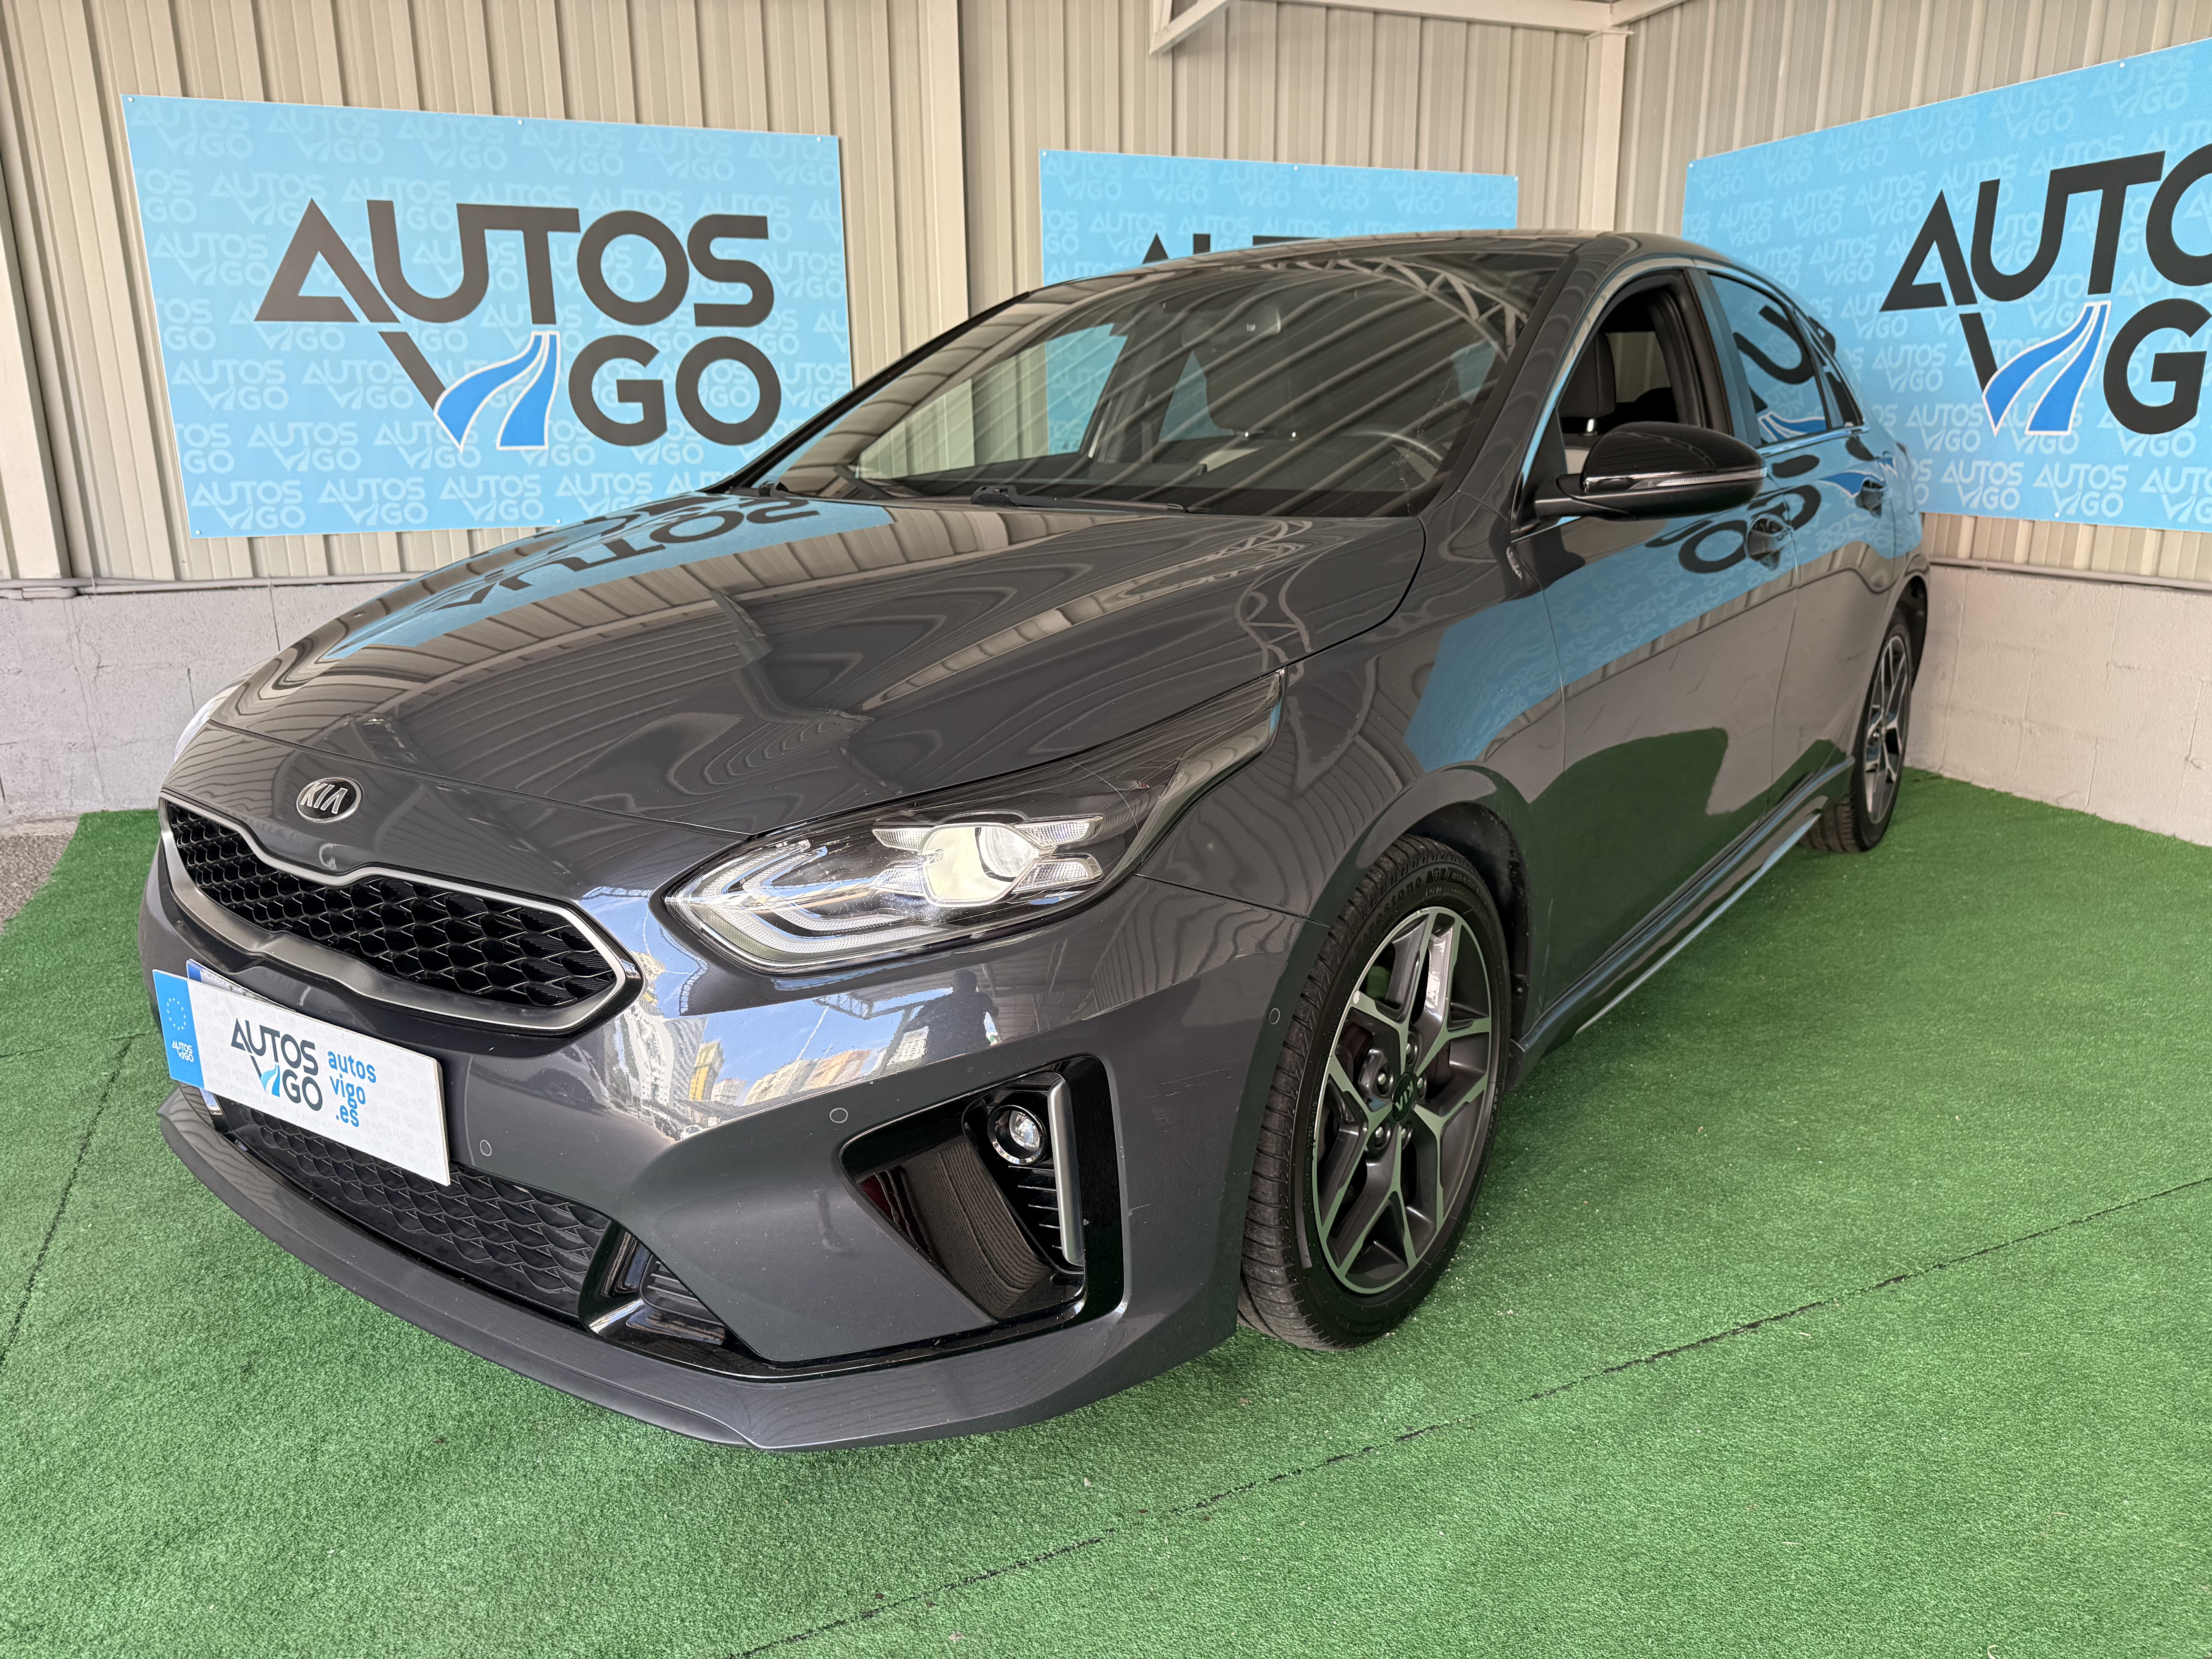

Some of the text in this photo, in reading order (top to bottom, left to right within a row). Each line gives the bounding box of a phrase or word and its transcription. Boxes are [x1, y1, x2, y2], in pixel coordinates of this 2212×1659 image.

[130, 103, 250, 131] AUTOS
[268, 108, 381, 137] AUTOS
[396, 114, 505, 144] AUTOS
[156, 126, 254, 158] VIGO
[291, 132, 383, 163] VIGO
[520, 122, 621, 151] AUTOS
[636, 129, 733, 156] AUTOS
[745, 136, 838, 162] AUTOS
[422, 140, 507, 170] VIGO
[542, 146, 624, 176] VIGO
[657, 153, 734, 181] VIGO
[211, 171, 326, 200] AUTOS
[767, 159, 838, 185] VIGO
[341, 177, 453, 205] AUTOS
[585, 188, 684, 214] AUTOS
[1781, 185, 1848, 218] AUTOS
[1853, 170, 1927, 207] AUTOS
[236, 197, 303, 226] VIG
[1090, 211, 1167, 234] AUTOS
[1716, 199, 1774, 229] AUTOS
[1864, 198, 1923, 226] VIGO
[1879, 143, 2212, 312] AUTO
[151, 232, 269, 260] AUTOS
[1809, 233, 1879, 264] AUTOS
[177, 257, 272, 286] VIGO
[254, 197, 775, 328] AUTOS
[1822, 259, 1874, 287] VIGO
[775, 274, 845, 298] VIGO
[253, 323, 346, 351] VIGO
[1853, 312, 1908, 340] VIGO
[1872, 343, 1948, 369] AUTOS
[1959, 298, 2212, 436] VIG
[170, 358, 287, 385] AUTOS
[301, 358, 412, 385] AUTOS
[781, 362, 849, 385] UTOS
[1887, 368, 1943, 392] VIGO
[196, 384, 289, 411] VIGO
[327, 383, 414, 410] VIGO
[378, 331, 781, 450] VIGO
[1905, 403, 1985, 428] AUTOS
[247, 421, 359, 448] AUTOS
[1920, 426, 1981, 452] VIGO
[272, 447, 361, 472] VIGO
[397, 445, 481, 469] VIGO
[439, 474, 542, 500] AUTOS
[555, 472, 653, 497] AUTOS
[1940, 460, 2025, 486] AUTOS
[2032, 462, 2129, 492] AUTOS
[192, 479, 303, 507] AUTOS
[318, 476, 426, 503] AUTOS
[1956, 483, 2020, 511] VIGO
[2052, 489, 2124, 518] VIGO
[216, 505, 306, 530] VIGO
[342, 501, 428, 526] VIGO
[462, 496, 544, 522] VIGO
[300, 782, 348, 814] KIA
[172, 1041, 193, 1054] AUTOS
[176, 1049, 194, 1063] VIGO
[231, 1017, 318, 1076] AUTOS
[328, 1051, 376, 1084] autos
[249, 1054, 323, 1111] VIGO
[329, 1074, 366, 1109] vigo
[1395, 1080, 1413, 1111] KIA
[336, 1103, 359, 1128] .es
